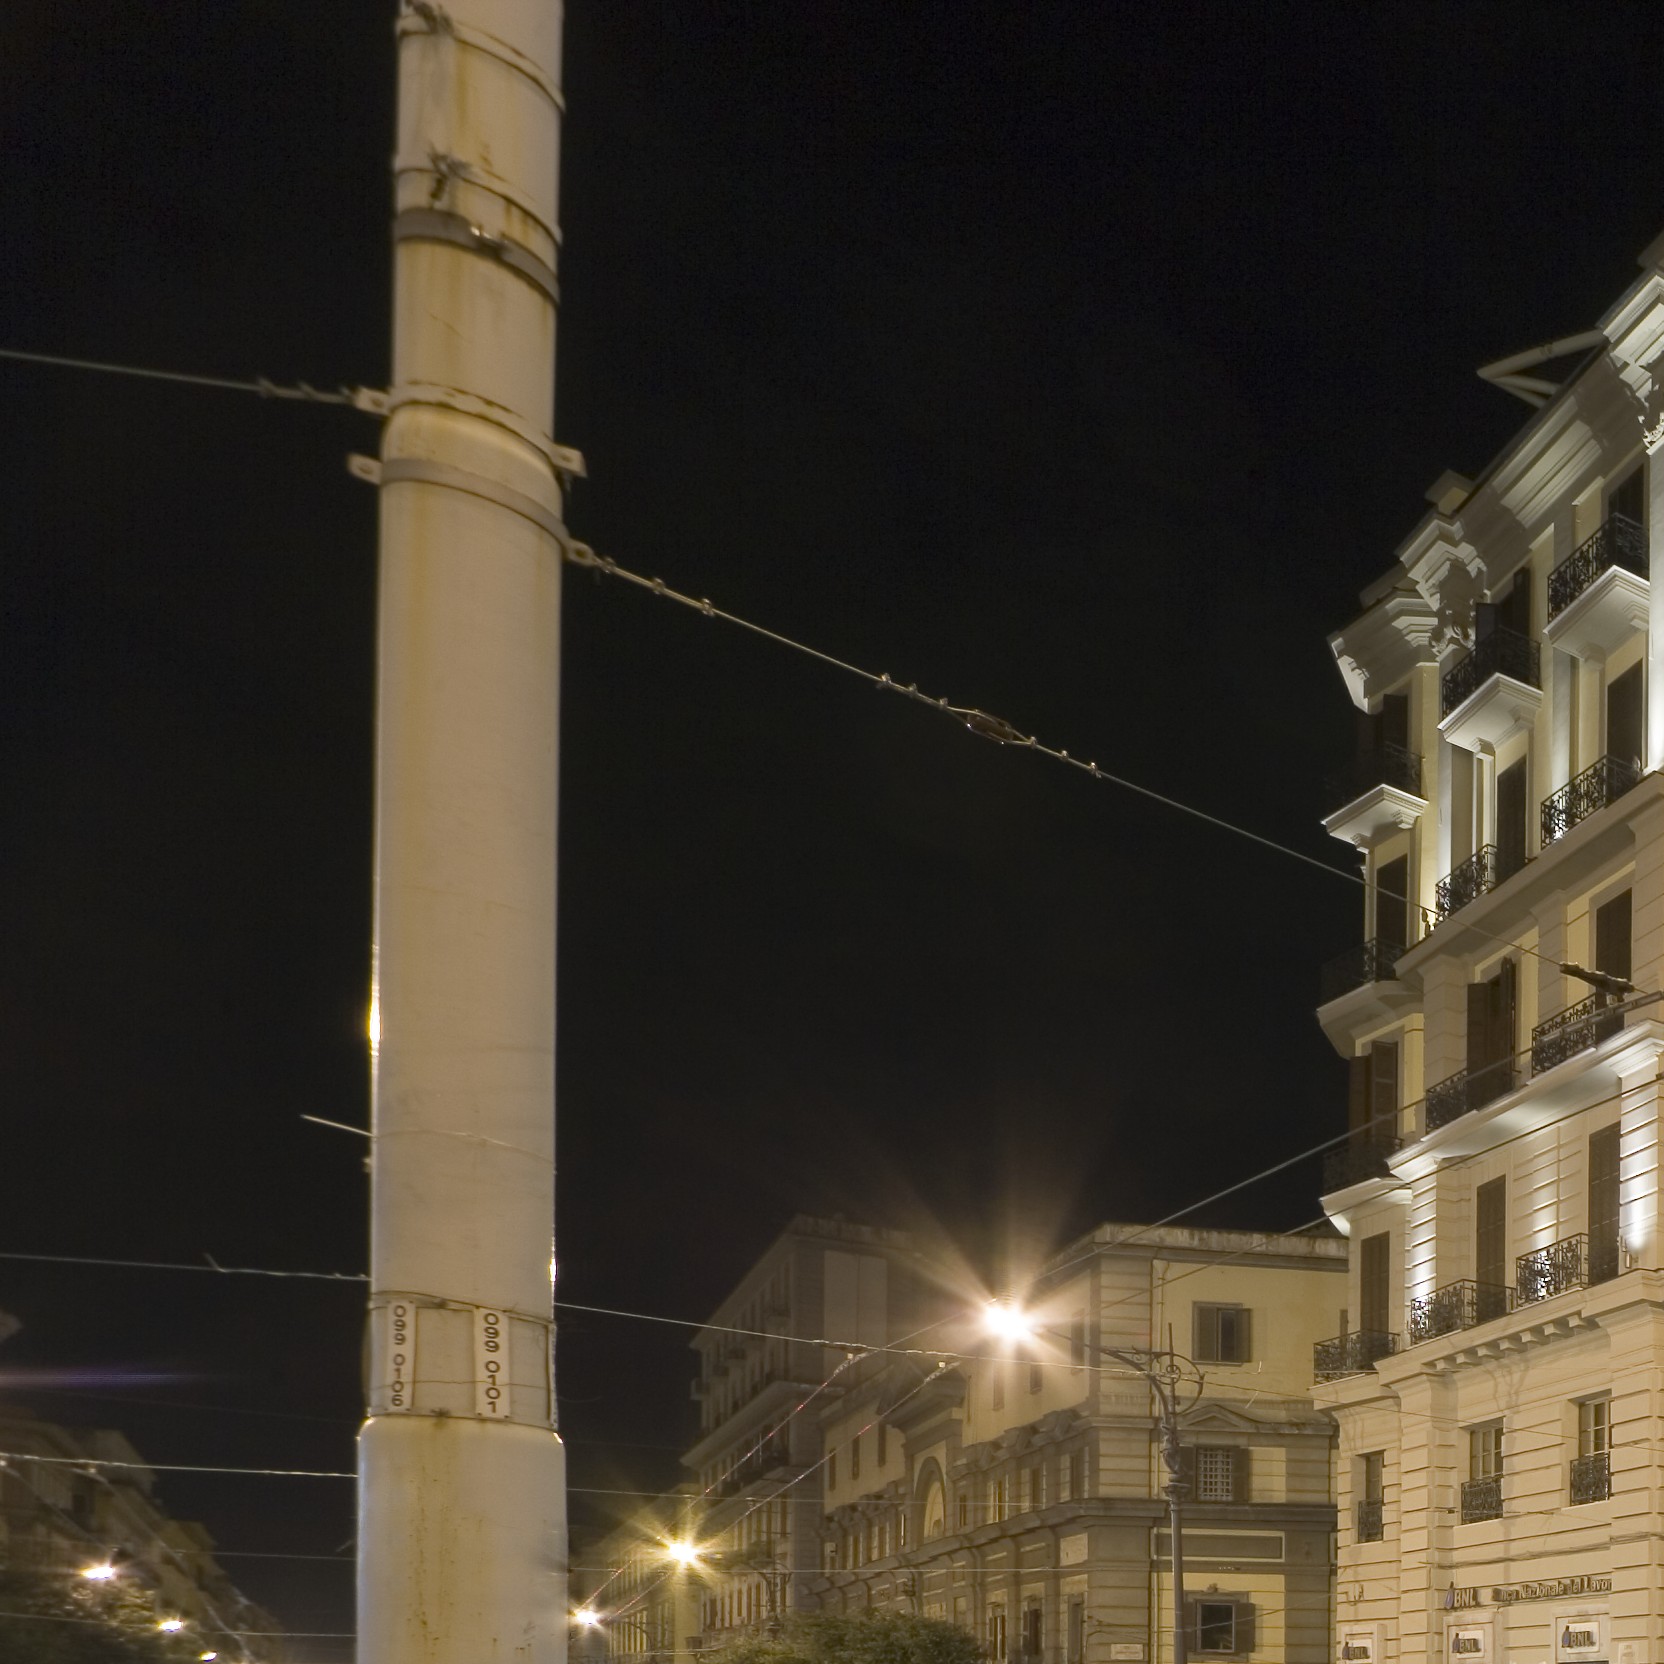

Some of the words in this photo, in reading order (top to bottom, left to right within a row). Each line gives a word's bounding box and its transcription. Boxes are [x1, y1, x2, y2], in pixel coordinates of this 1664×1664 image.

[484, 1313, 501, 1353] 099
[391, 1353, 406, 1407] 0106
[485, 1360, 501, 1414] 0101
[1453, 1588, 1479, 1608] BNL
[1570, 1631, 1595, 1648] BNL
